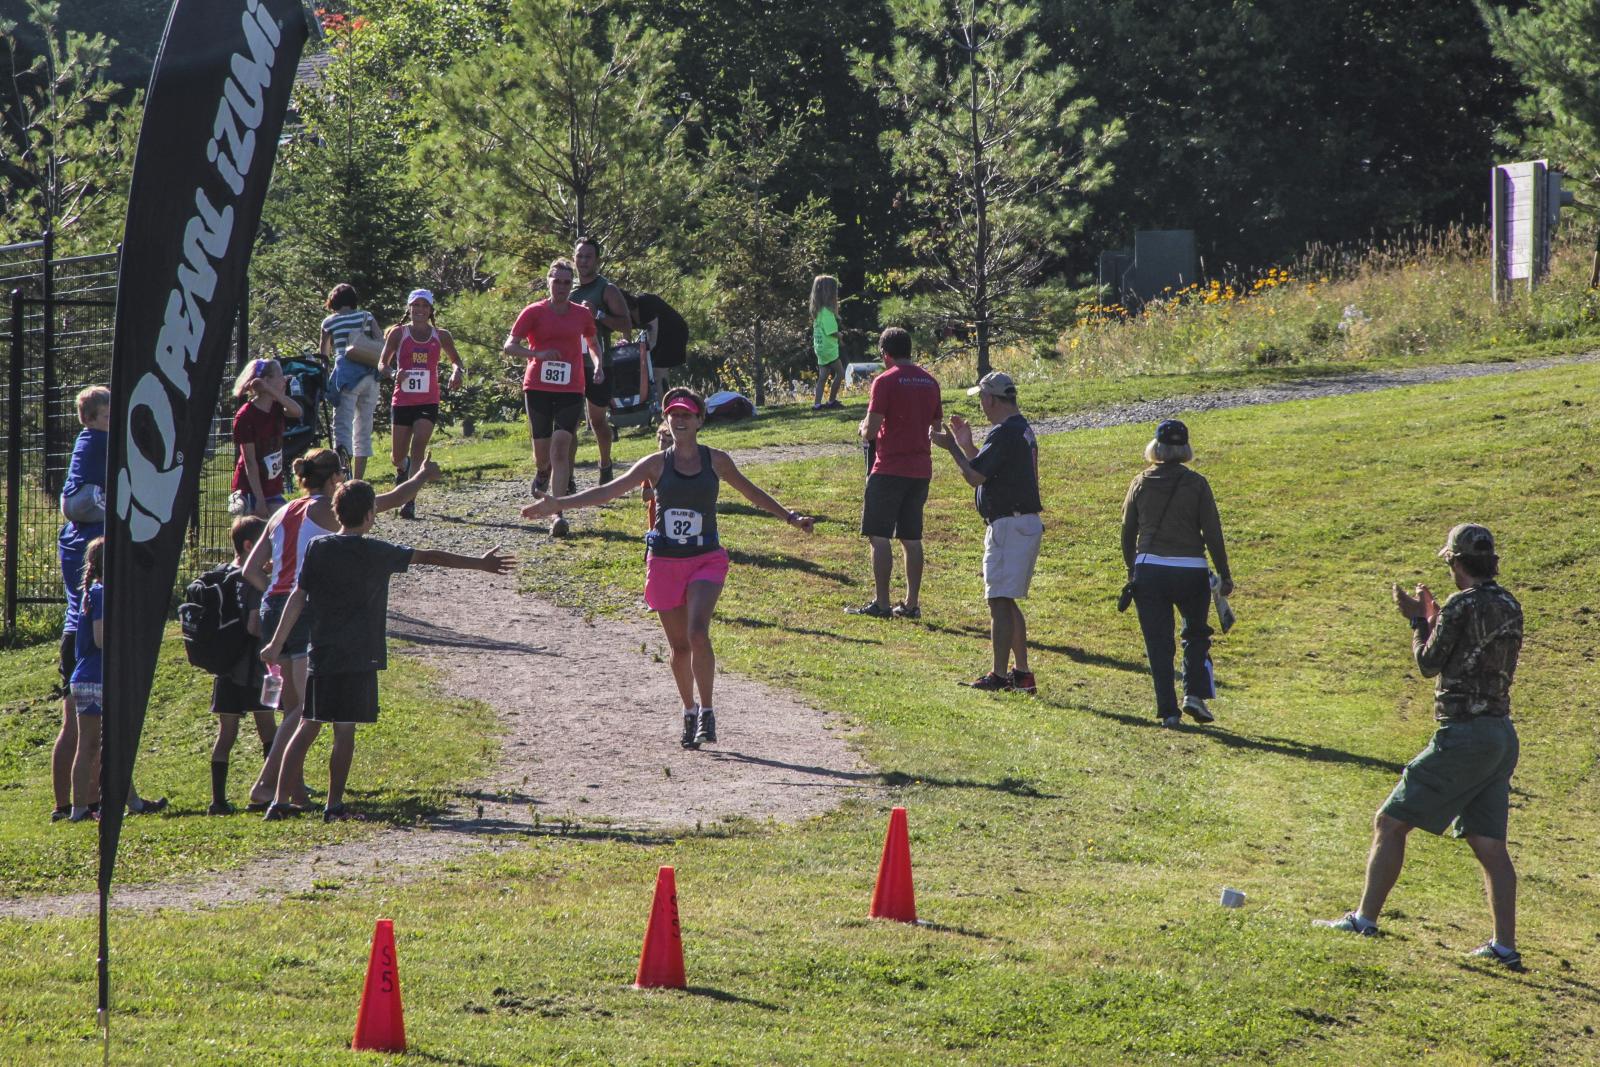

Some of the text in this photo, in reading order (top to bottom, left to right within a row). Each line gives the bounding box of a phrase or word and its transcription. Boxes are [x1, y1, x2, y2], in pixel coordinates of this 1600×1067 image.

[545, 368, 565, 382] 931
[408, 378, 426, 390] 91
[673, 520, 692, 536] 32
